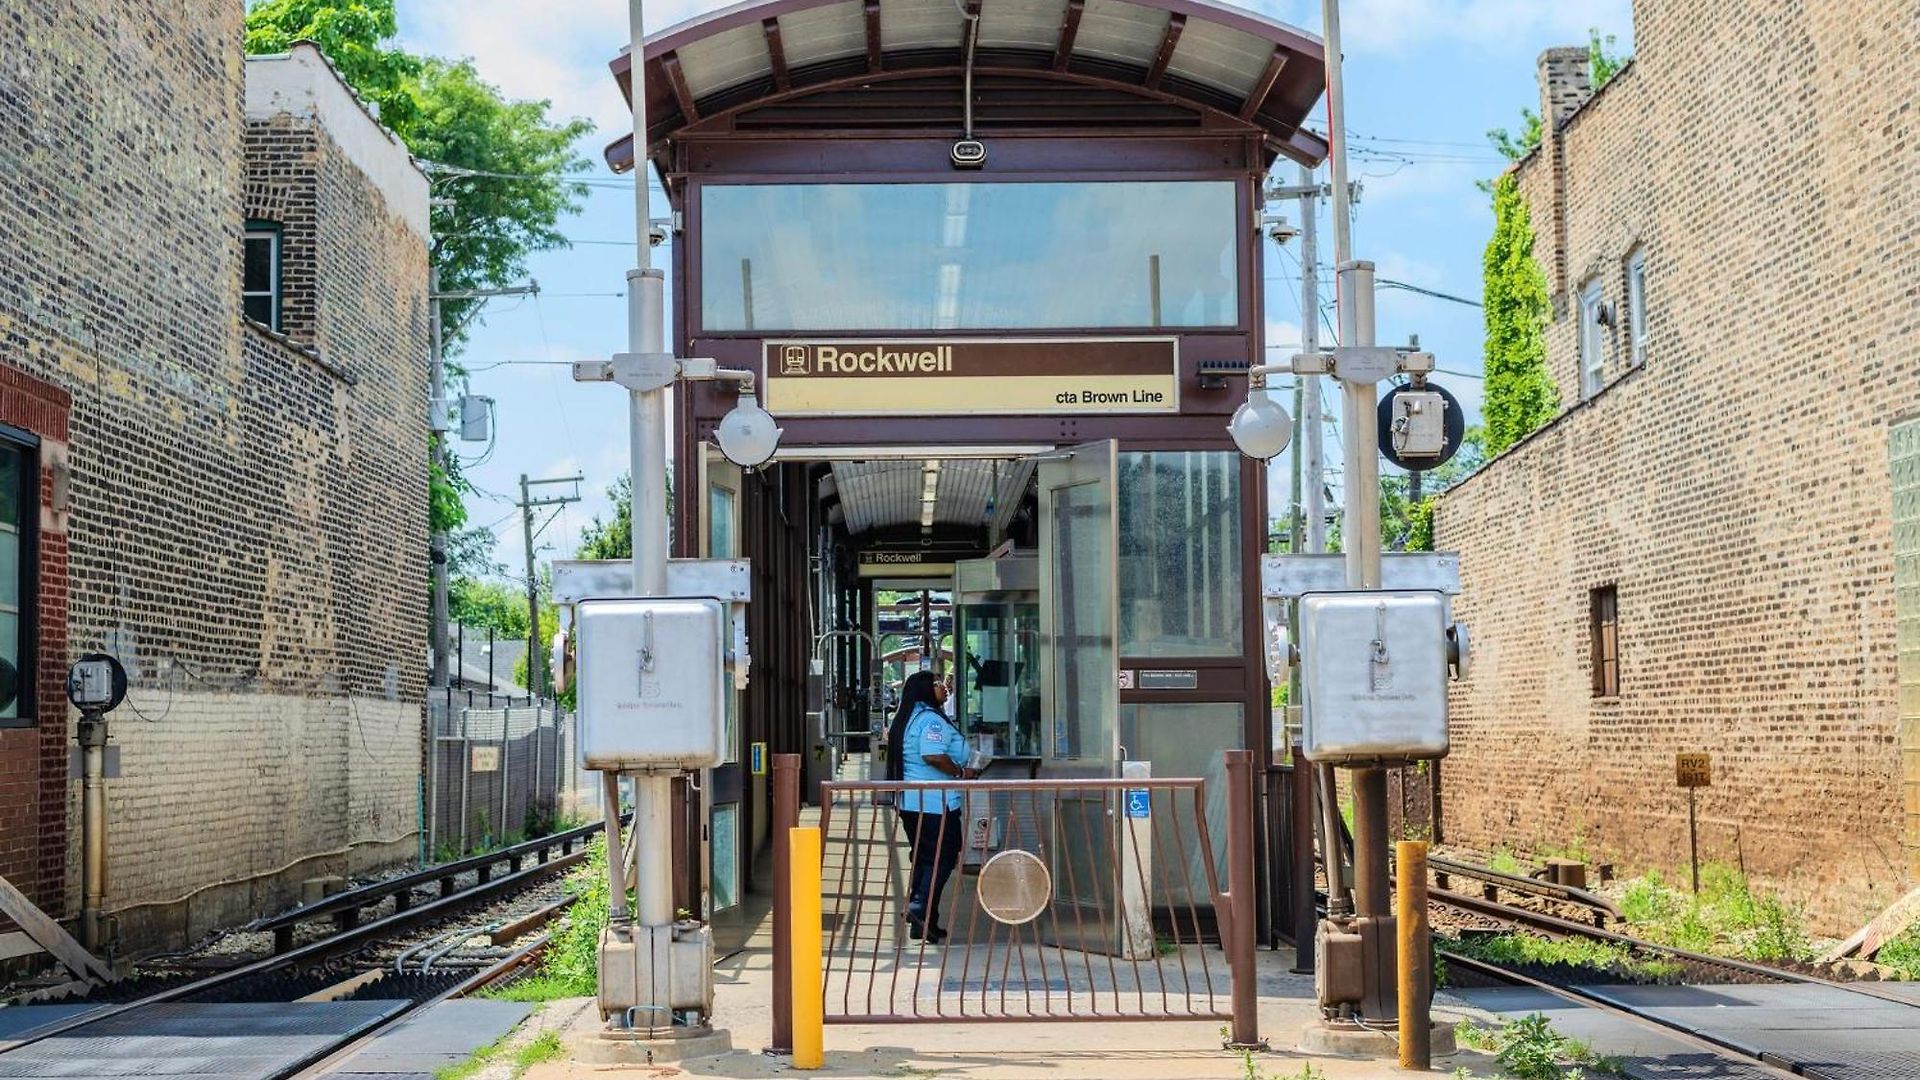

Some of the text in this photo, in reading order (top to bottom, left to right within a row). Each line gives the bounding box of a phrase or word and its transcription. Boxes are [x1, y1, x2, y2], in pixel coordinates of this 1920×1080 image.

[817, 346, 952, 372] Rockwell
[1056, 389, 1163, 404] cta Brown Line
[876, 553, 921, 563] Rockwell
[1681, 758, 1705, 769] RV2
